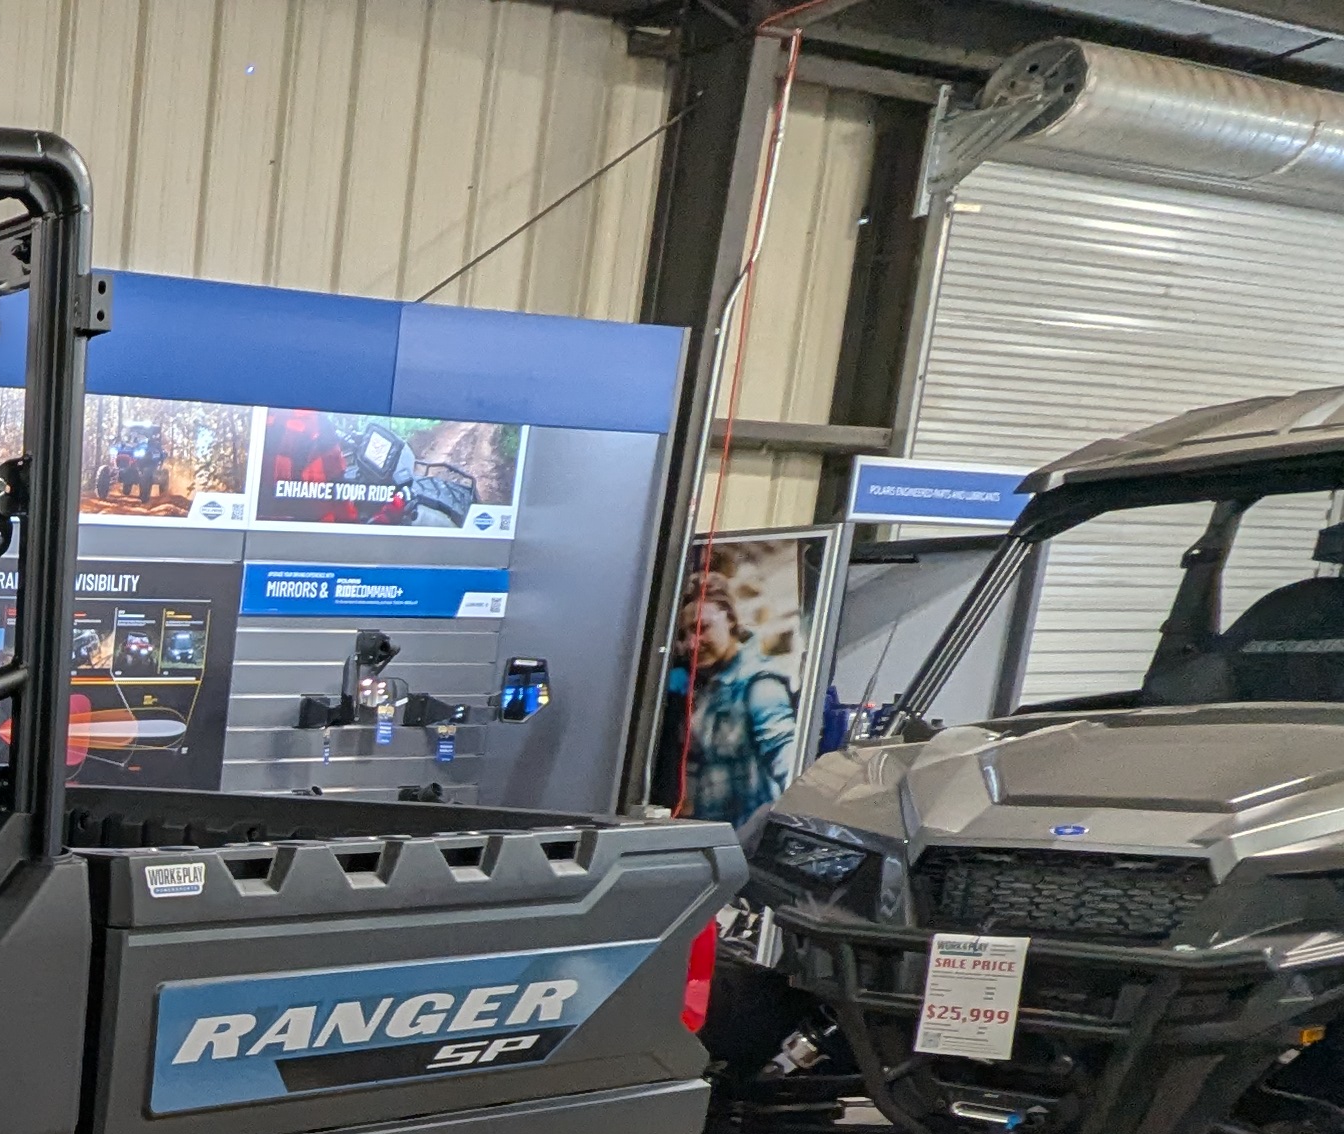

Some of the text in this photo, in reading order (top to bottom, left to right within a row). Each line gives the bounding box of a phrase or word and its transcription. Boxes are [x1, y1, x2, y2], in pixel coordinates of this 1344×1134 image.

[275, 480, 396, 502] ENHANCE YOUR RIDE
[75, 573, 140, 592] VISIBILITY
[266, 580, 329, 599] MIRRORS &
[934, 957, 1016, 972] SALE PRICE
[171, 978, 579, 1065] RANGER
[926, 1003, 1010, 1025] $25,999
[426, 1035, 541, 1070] SP
